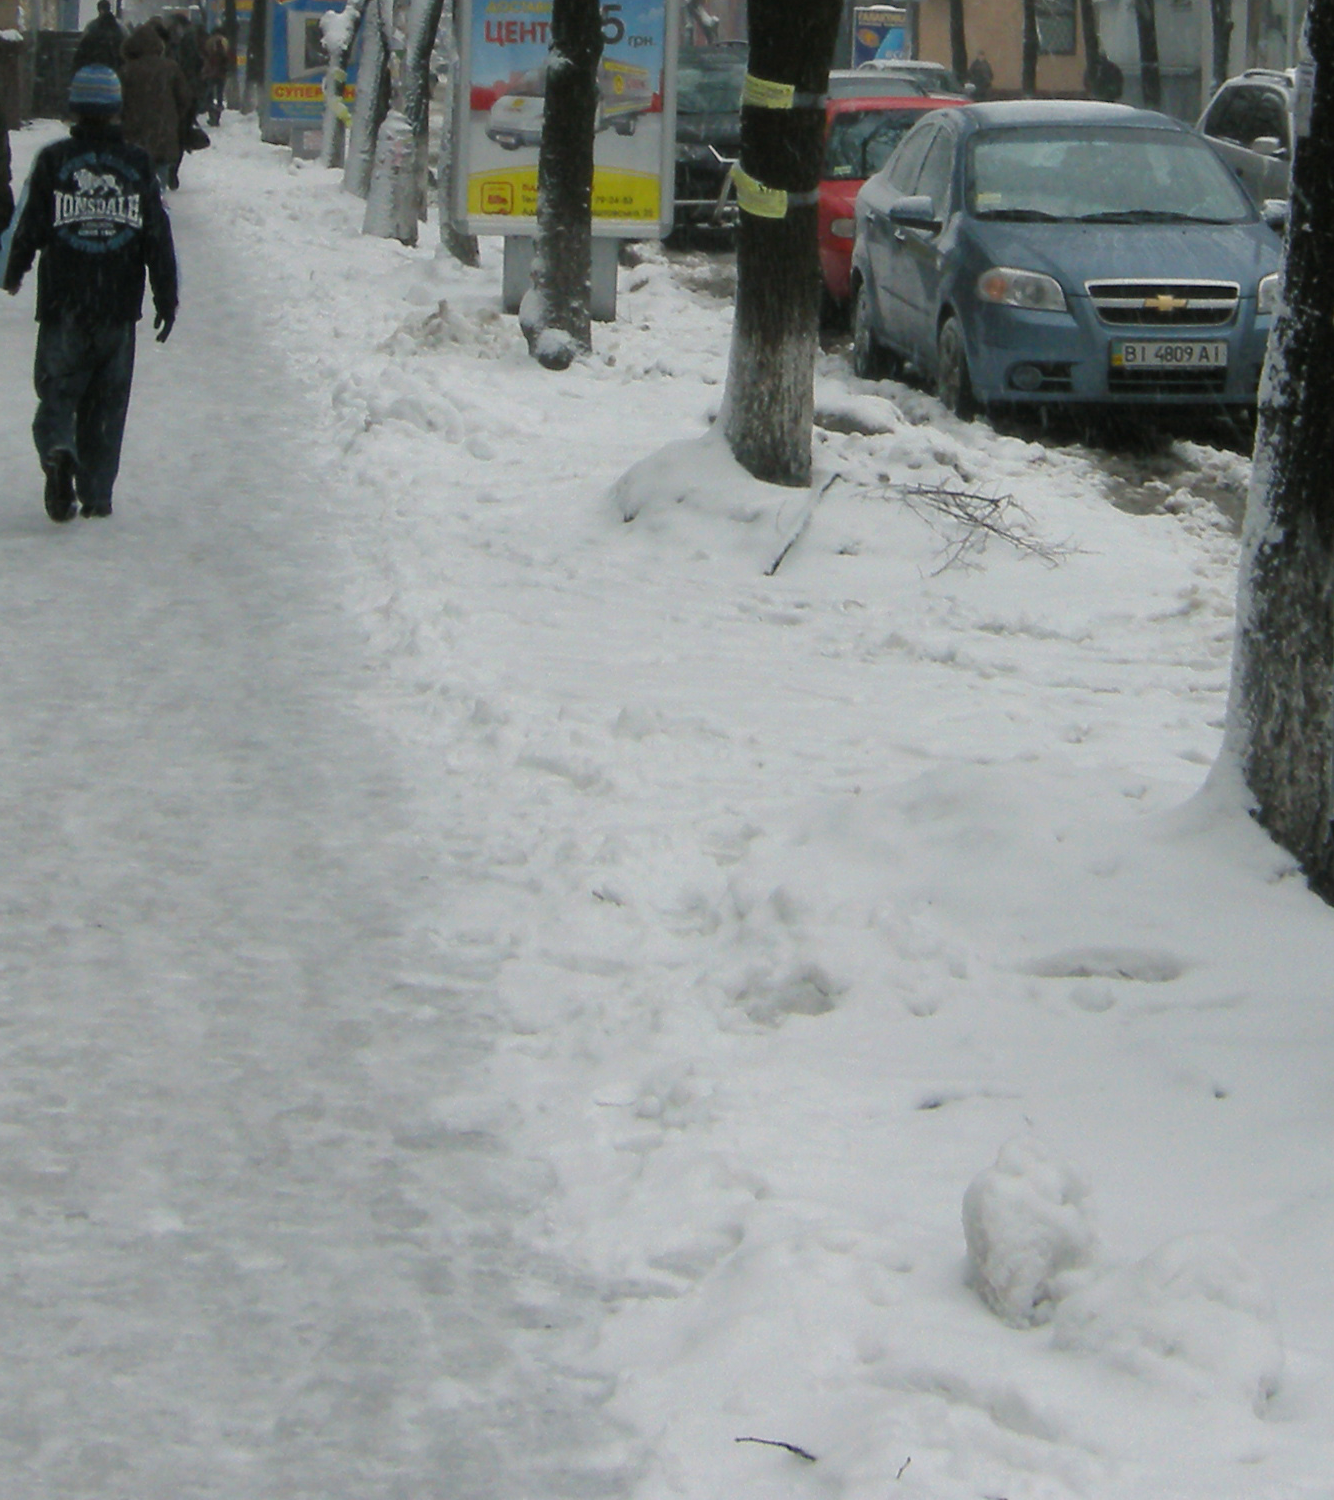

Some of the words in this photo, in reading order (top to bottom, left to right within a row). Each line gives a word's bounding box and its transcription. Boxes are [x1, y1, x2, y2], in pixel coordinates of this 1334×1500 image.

[485, 21, 553, 47] ЦЕНТ
[53, 190, 144, 228] LONSDALE
[1154, 345, 1194, 363] 4809
